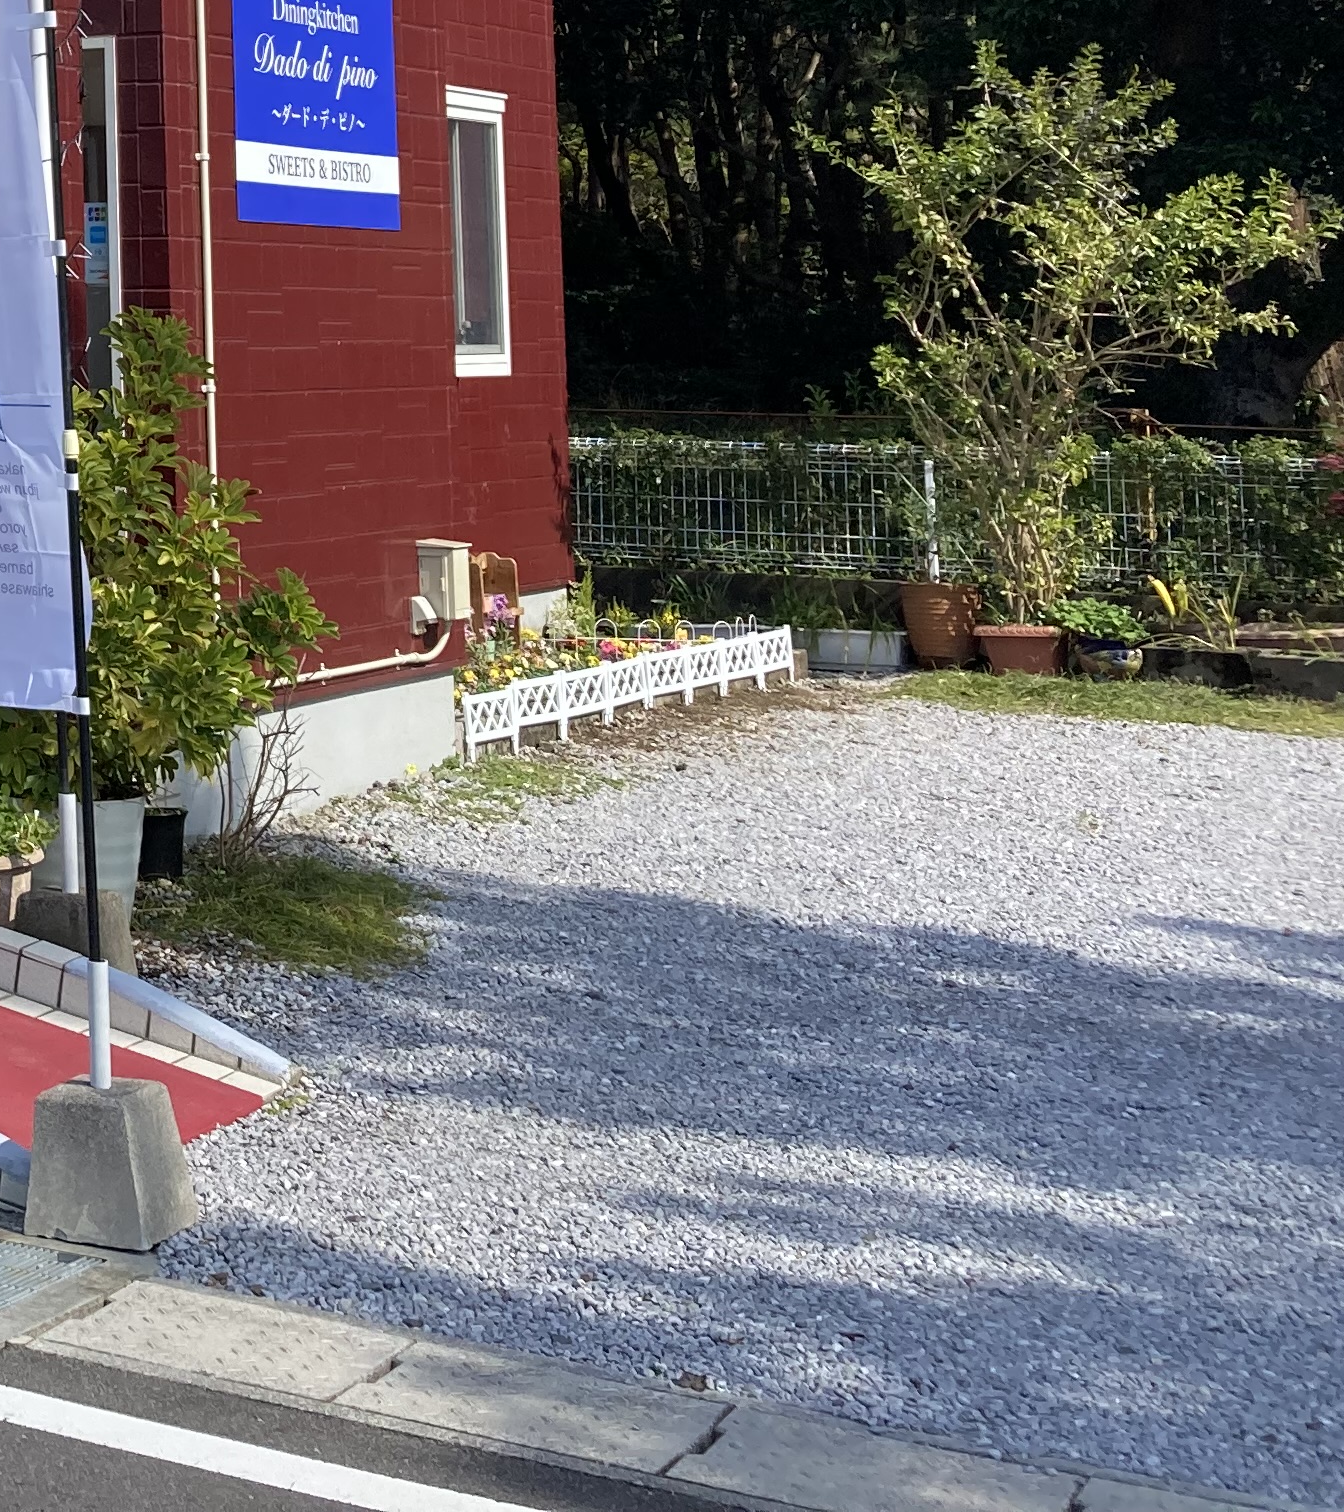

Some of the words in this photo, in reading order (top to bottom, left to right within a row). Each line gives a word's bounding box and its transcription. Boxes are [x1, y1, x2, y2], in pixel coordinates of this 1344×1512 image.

[253, 32, 310, 80] Dado
[312, 44, 333, 83] di
[335, 55, 378, 100] pino
[268, 153, 315, 179] SWEETS
[318, 159, 328, 180] &
[331, 160, 371, 183] BISTRO
